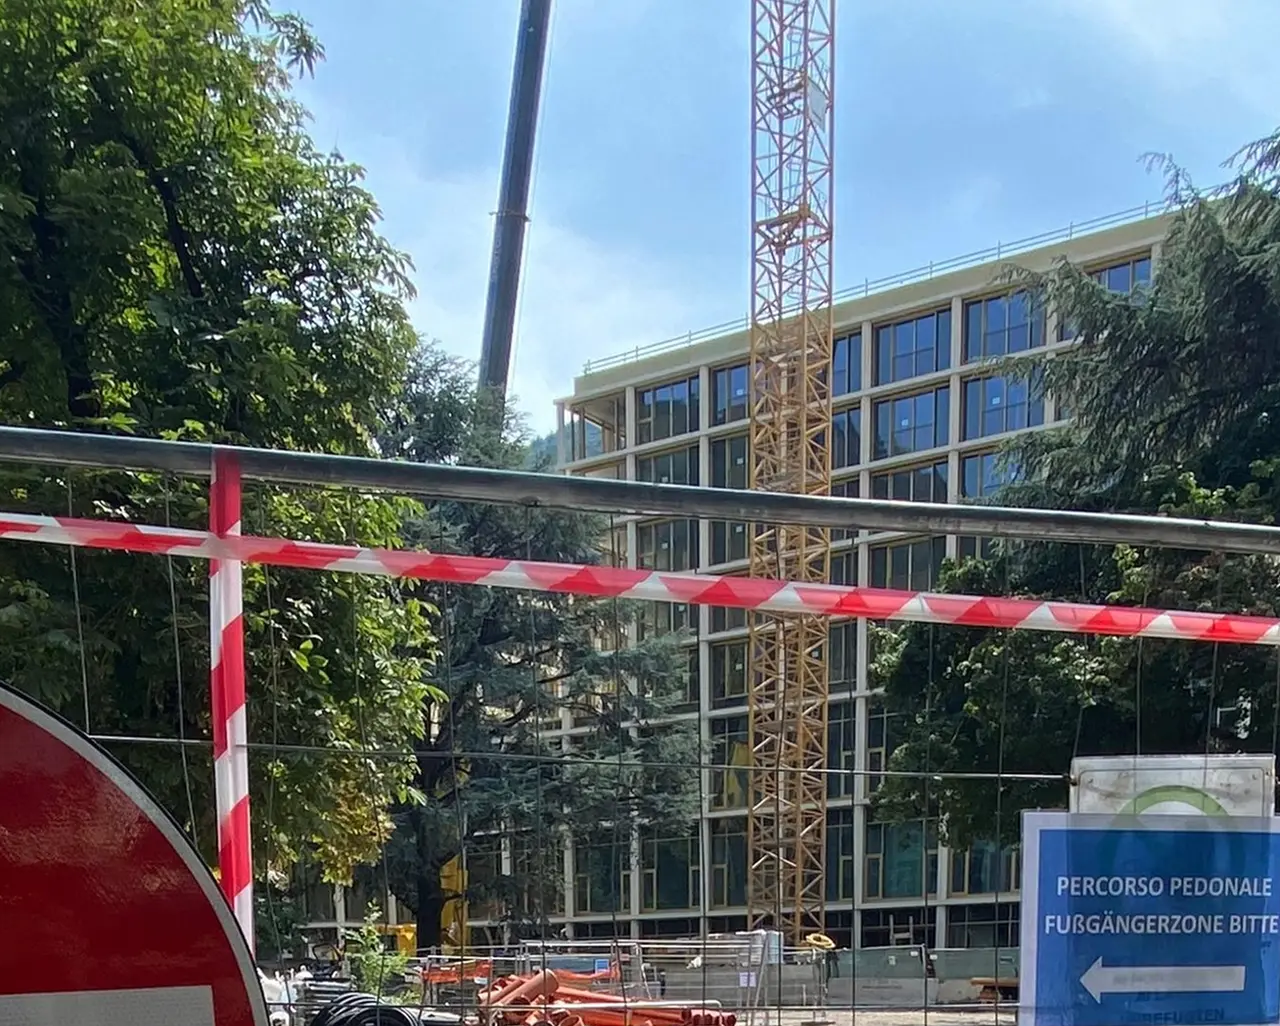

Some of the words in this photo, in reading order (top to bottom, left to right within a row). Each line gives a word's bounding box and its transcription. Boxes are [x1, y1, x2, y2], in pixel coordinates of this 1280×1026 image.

[1057, 876, 1164, 896] PERCORSO
[1170, 877, 1273, 897] PEDONALE
[1044, 910, 1224, 935] FUßGÄNGERZONE
[1229, 914, 1280, 934] BITTE
